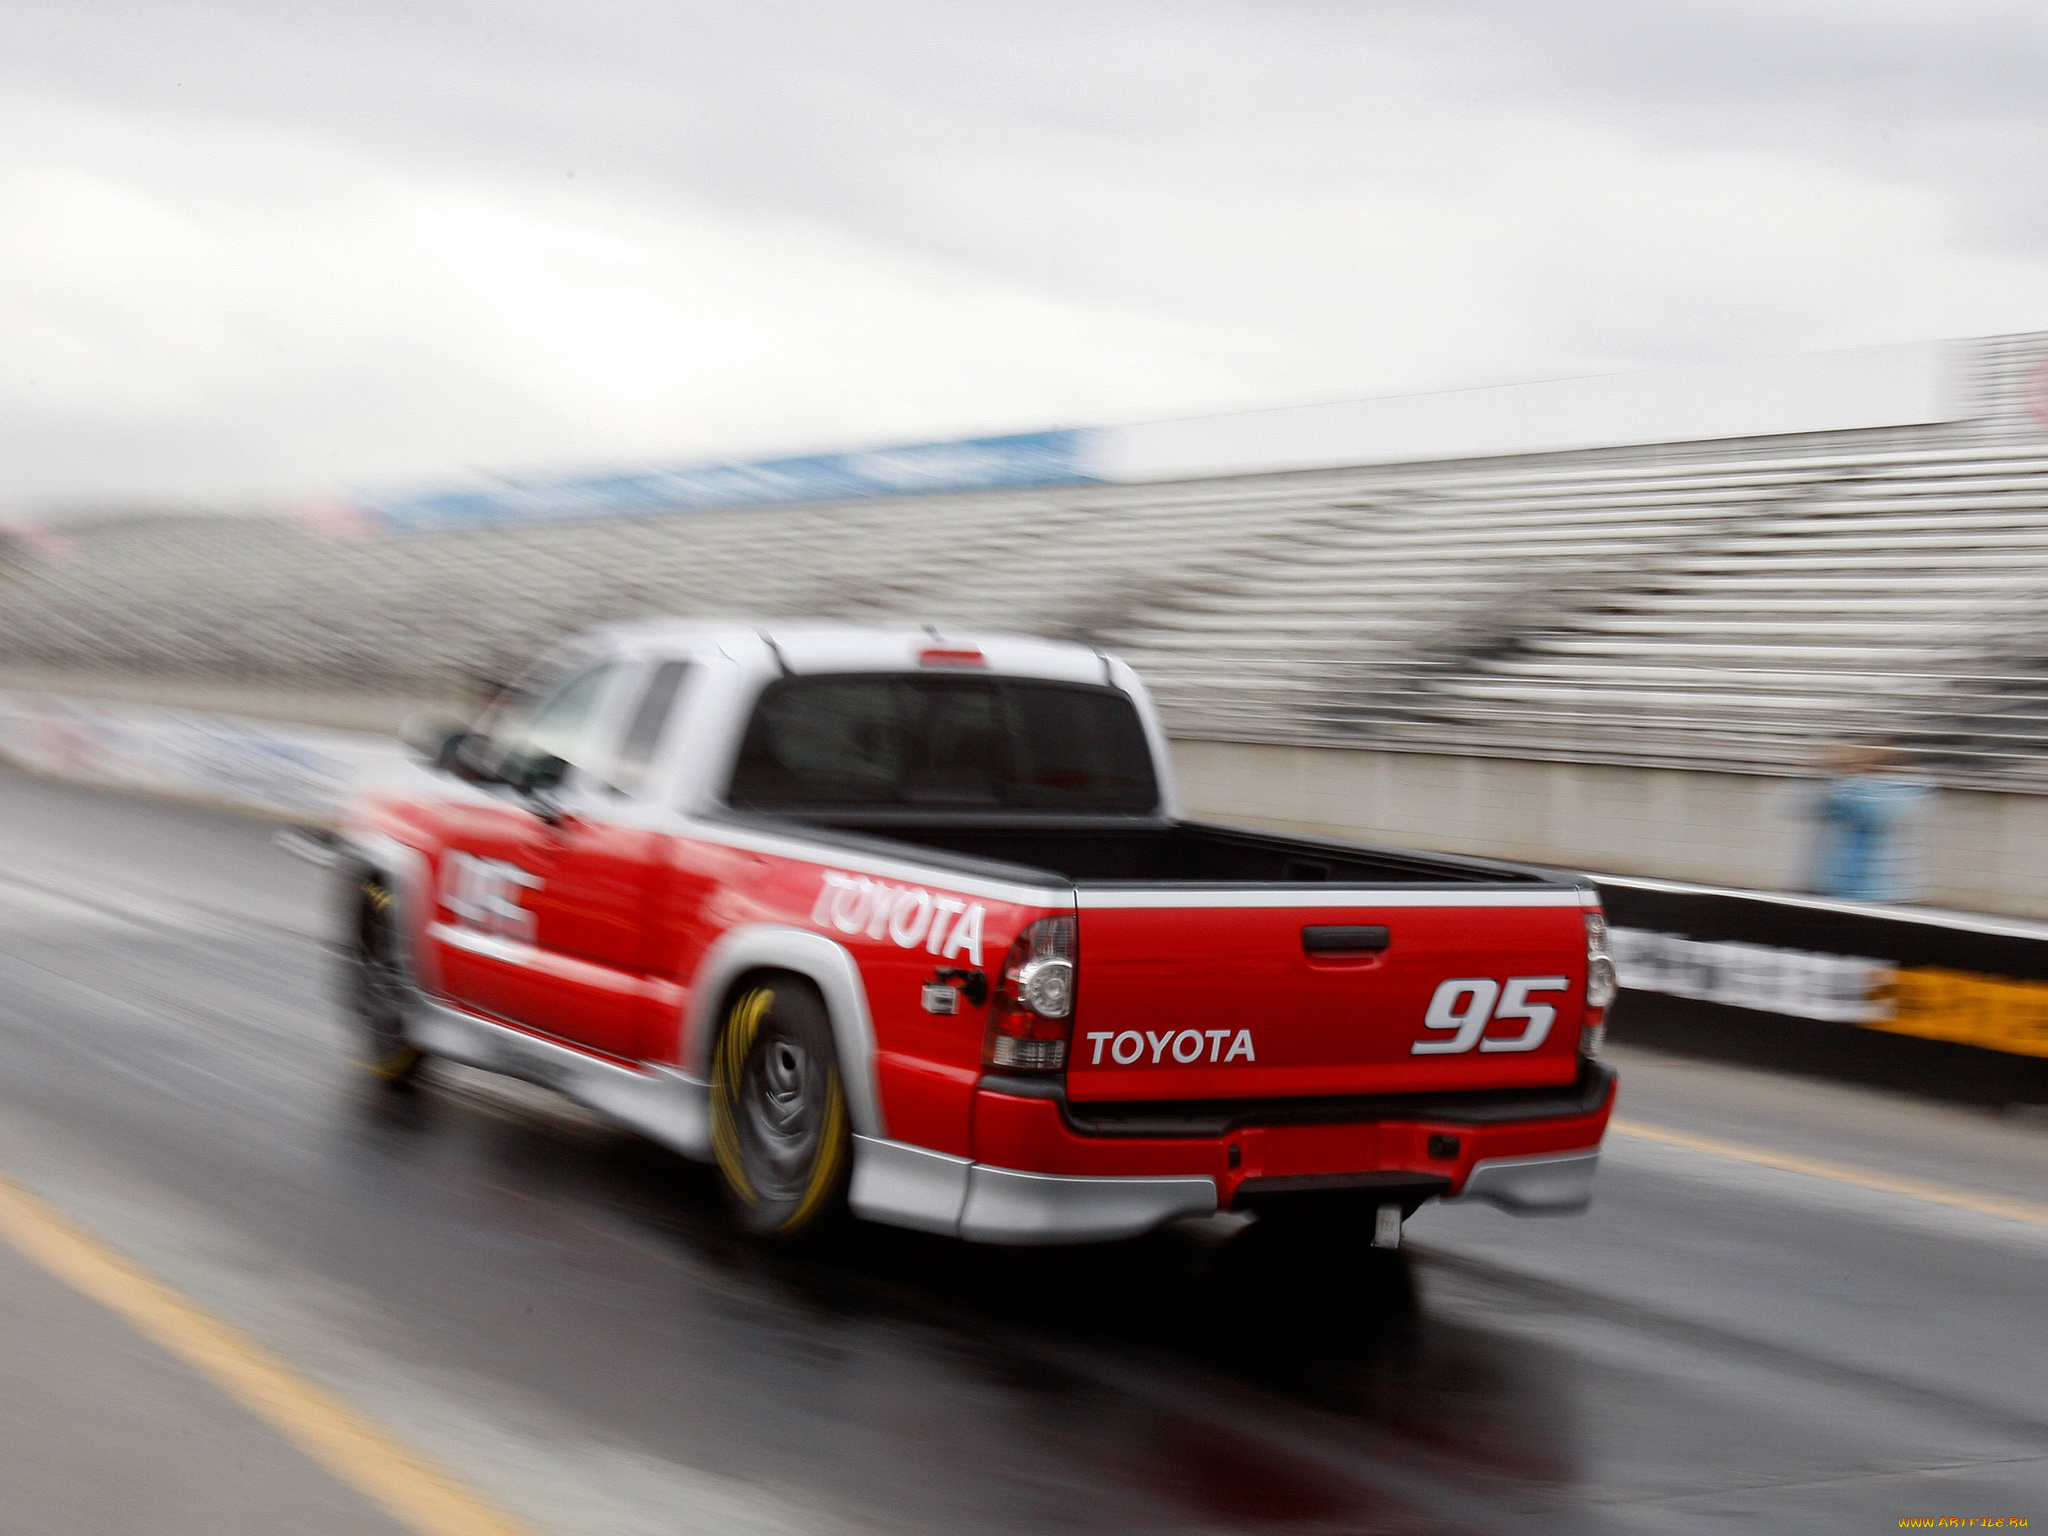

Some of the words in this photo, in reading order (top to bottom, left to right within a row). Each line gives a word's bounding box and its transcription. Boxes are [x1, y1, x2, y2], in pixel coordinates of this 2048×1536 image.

[811, 869, 987, 966] TOYOTA
[1087, 1029, 1256, 1065] TOYOTA
[1411, 976, 1570, 1055] 95
